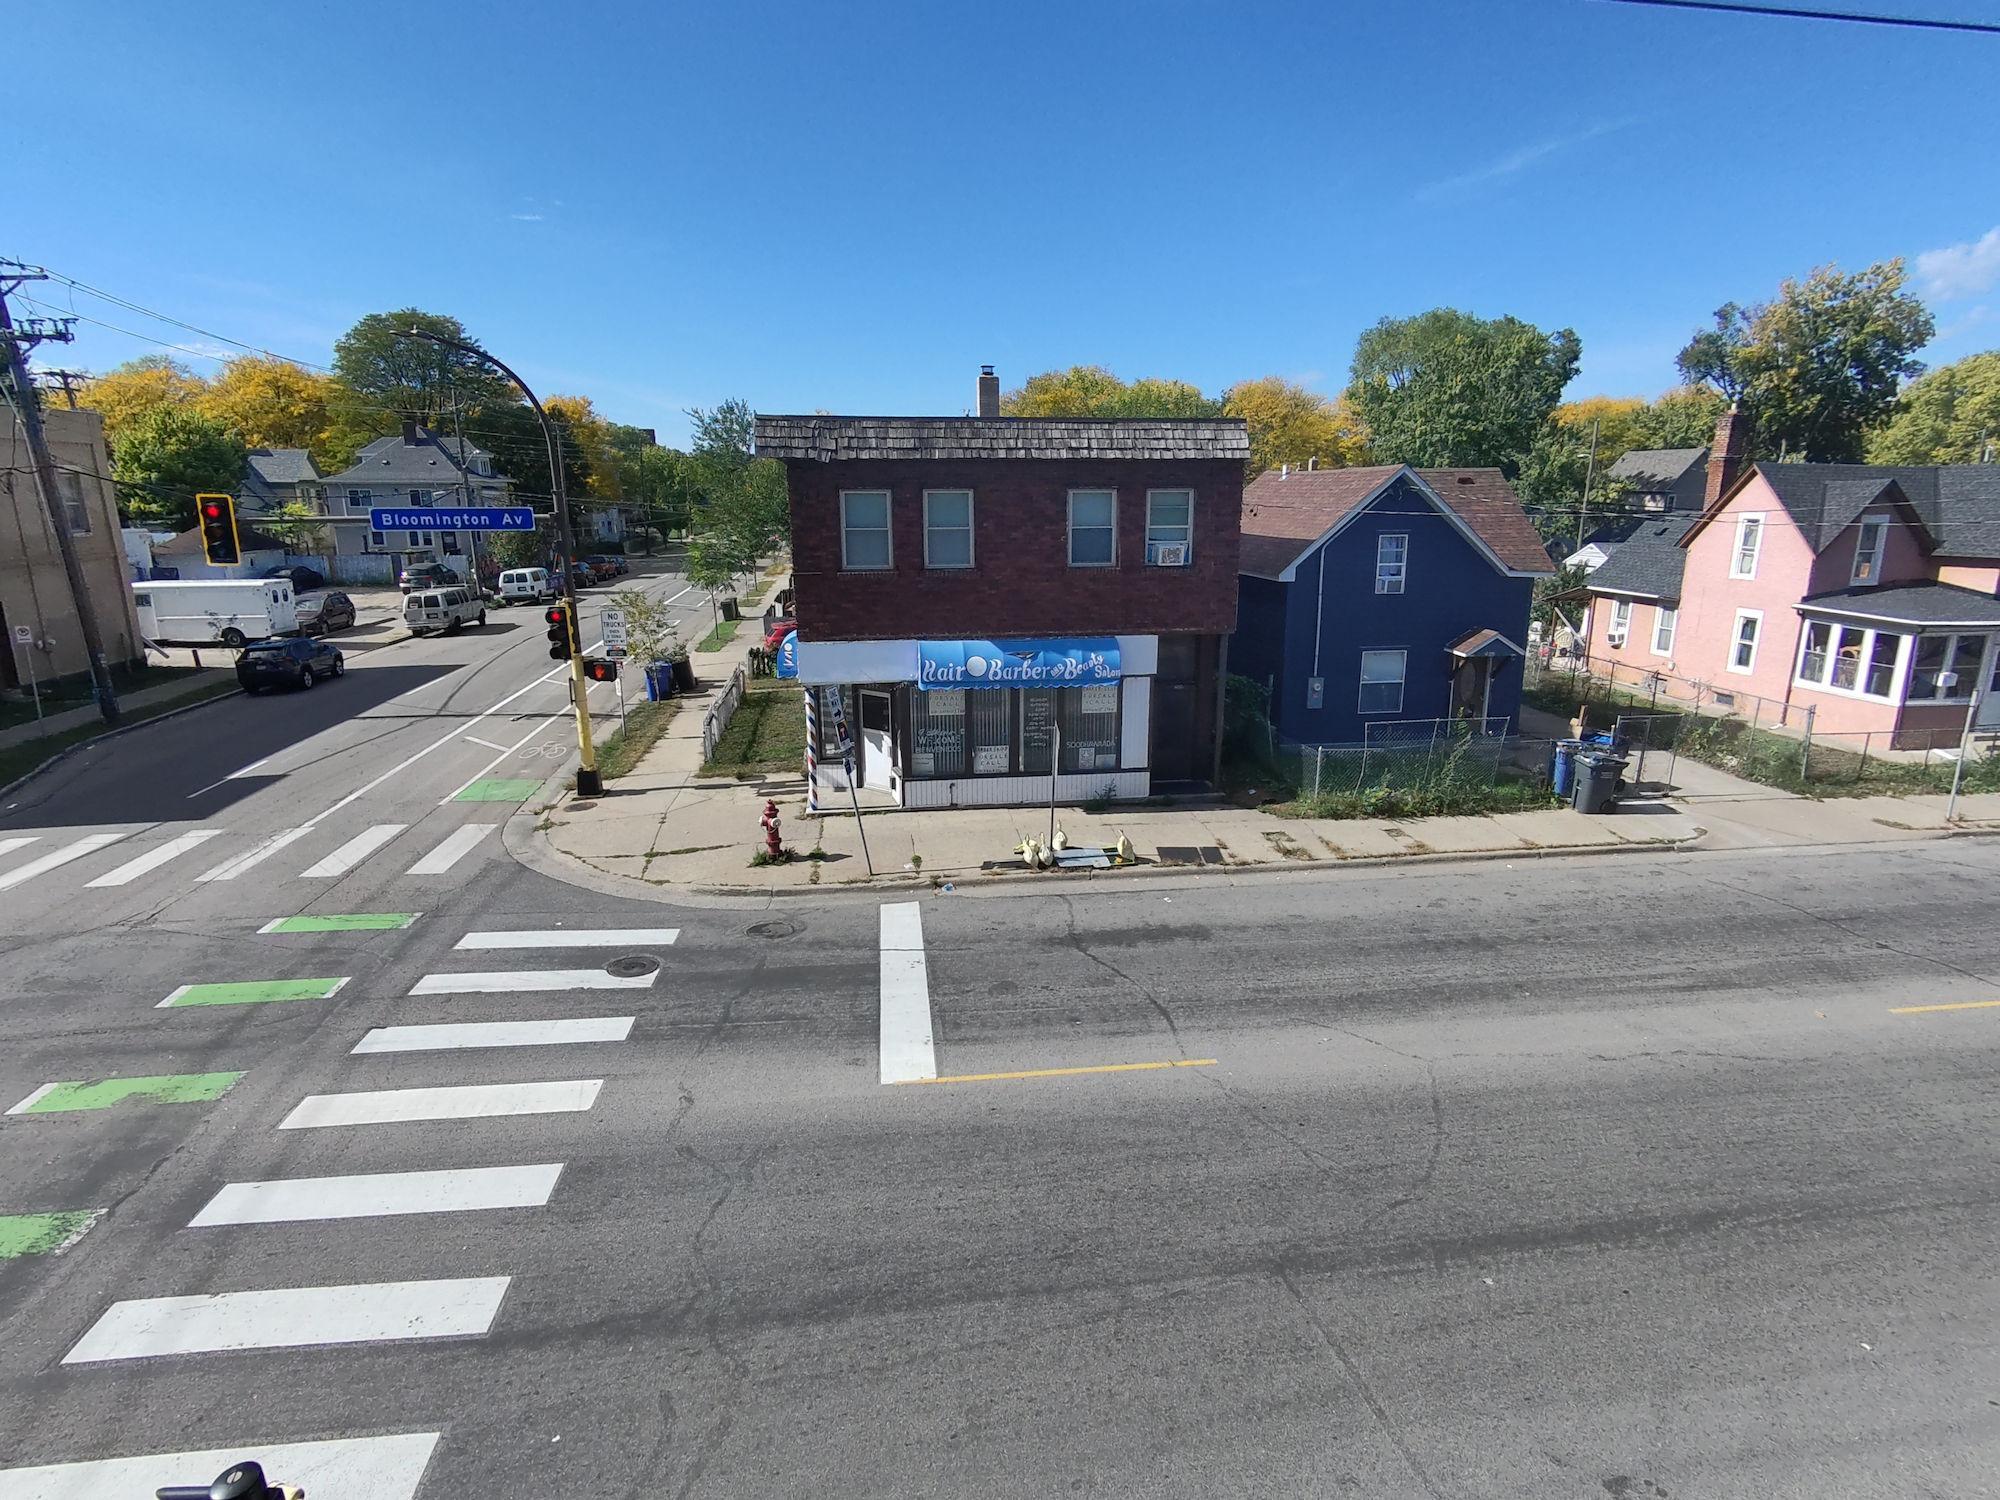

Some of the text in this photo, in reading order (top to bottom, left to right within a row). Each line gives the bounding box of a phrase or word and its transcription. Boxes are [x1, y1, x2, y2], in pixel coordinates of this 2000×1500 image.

[381, 513, 523, 528] Bloomington Av
[923, 659, 967, 682] Hair
[988, 657, 1051, 681] Barber
[1063, 652, 1104, 680] Beauty
